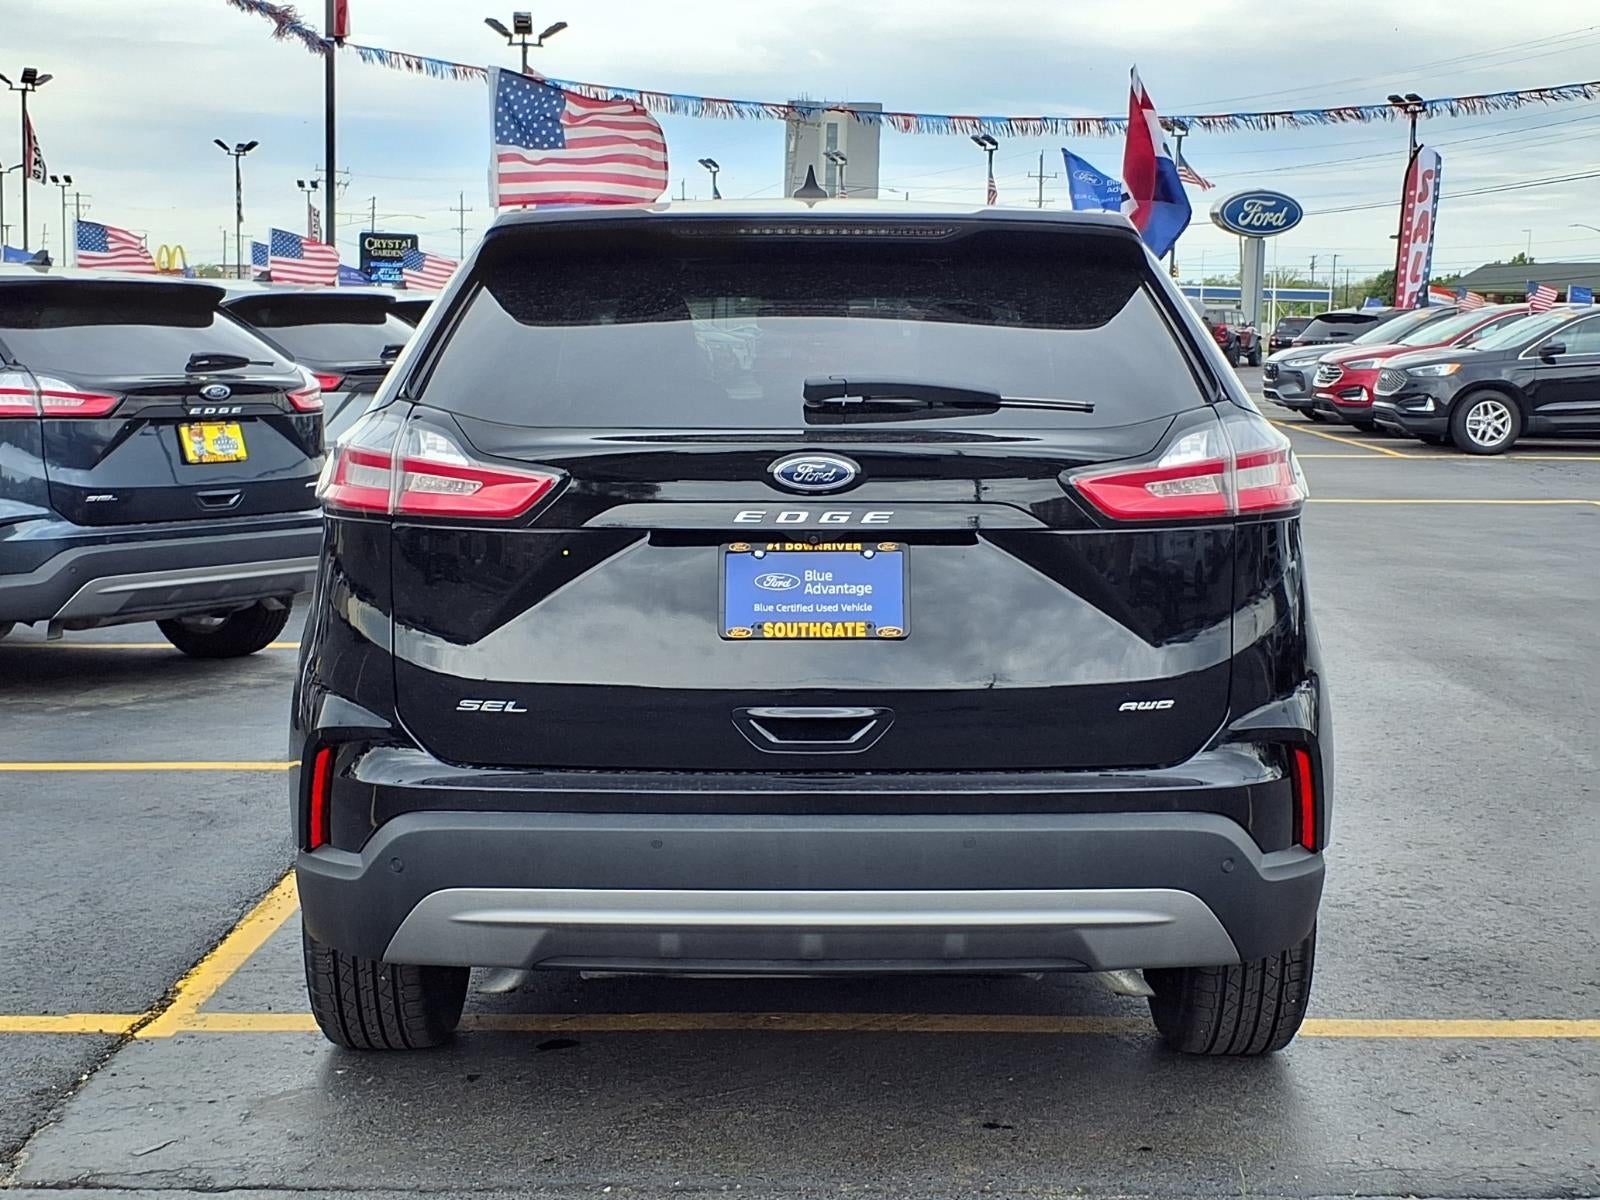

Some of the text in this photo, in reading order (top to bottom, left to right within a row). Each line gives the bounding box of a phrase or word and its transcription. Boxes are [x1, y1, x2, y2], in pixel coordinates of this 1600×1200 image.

[1238, 199, 1288, 226] Ford
[189, 406, 242, 415] EDGE
[792, 462, 836, 482] Ford
[733, 510, 894, 523] EDGE
[766, 543, 780, 551] #1
[763, 575, 792, 588] Ford
[804, 570, 833, 582] Blue
[804, 583, 873, 596] Advantage
[754, 603, 873, 612] Blue Certified Used Vehicle
[763, 622, 867, 638] SOUTHGATE
[456, 699, 528, 712] SEL
[1118, 699, 1175, 711] AWD
